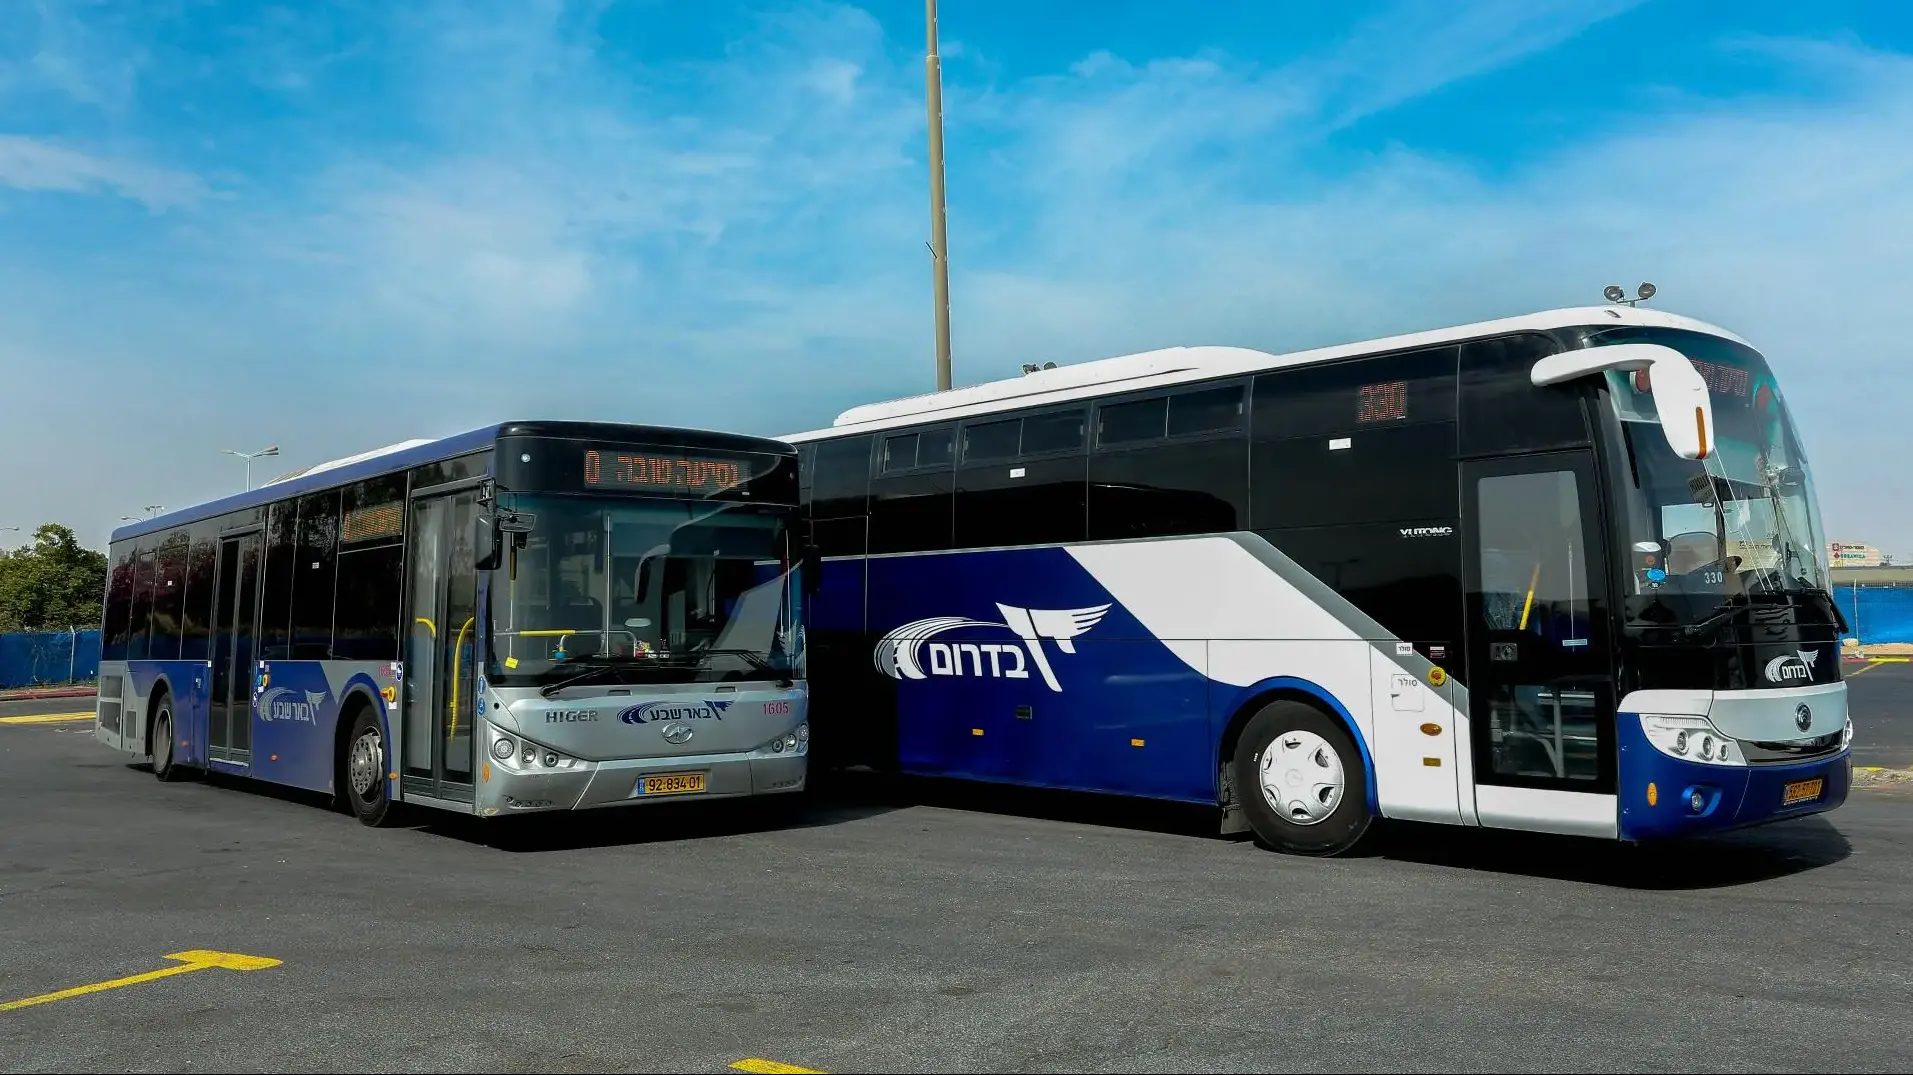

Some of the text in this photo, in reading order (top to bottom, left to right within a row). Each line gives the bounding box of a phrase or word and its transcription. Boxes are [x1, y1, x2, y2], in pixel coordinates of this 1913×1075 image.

[1359, 382, 1405, 421] 330
[616, 455, 672, 484] טובה
[1399, 526, 1453, 538] YUTONG
[1704, 571, 1724, 584] 330
[928, 642, 1030, 679] בדרום
[1781, 664, 1807, 679] בדרום
[1396, 677, 1418, 687] סולר
[686, 708, 713, 720] באר
[762, 702, 790, 715] 1605
[545, 709, 599, 724] HIGER
[650, 709, 684, 722] שבע
